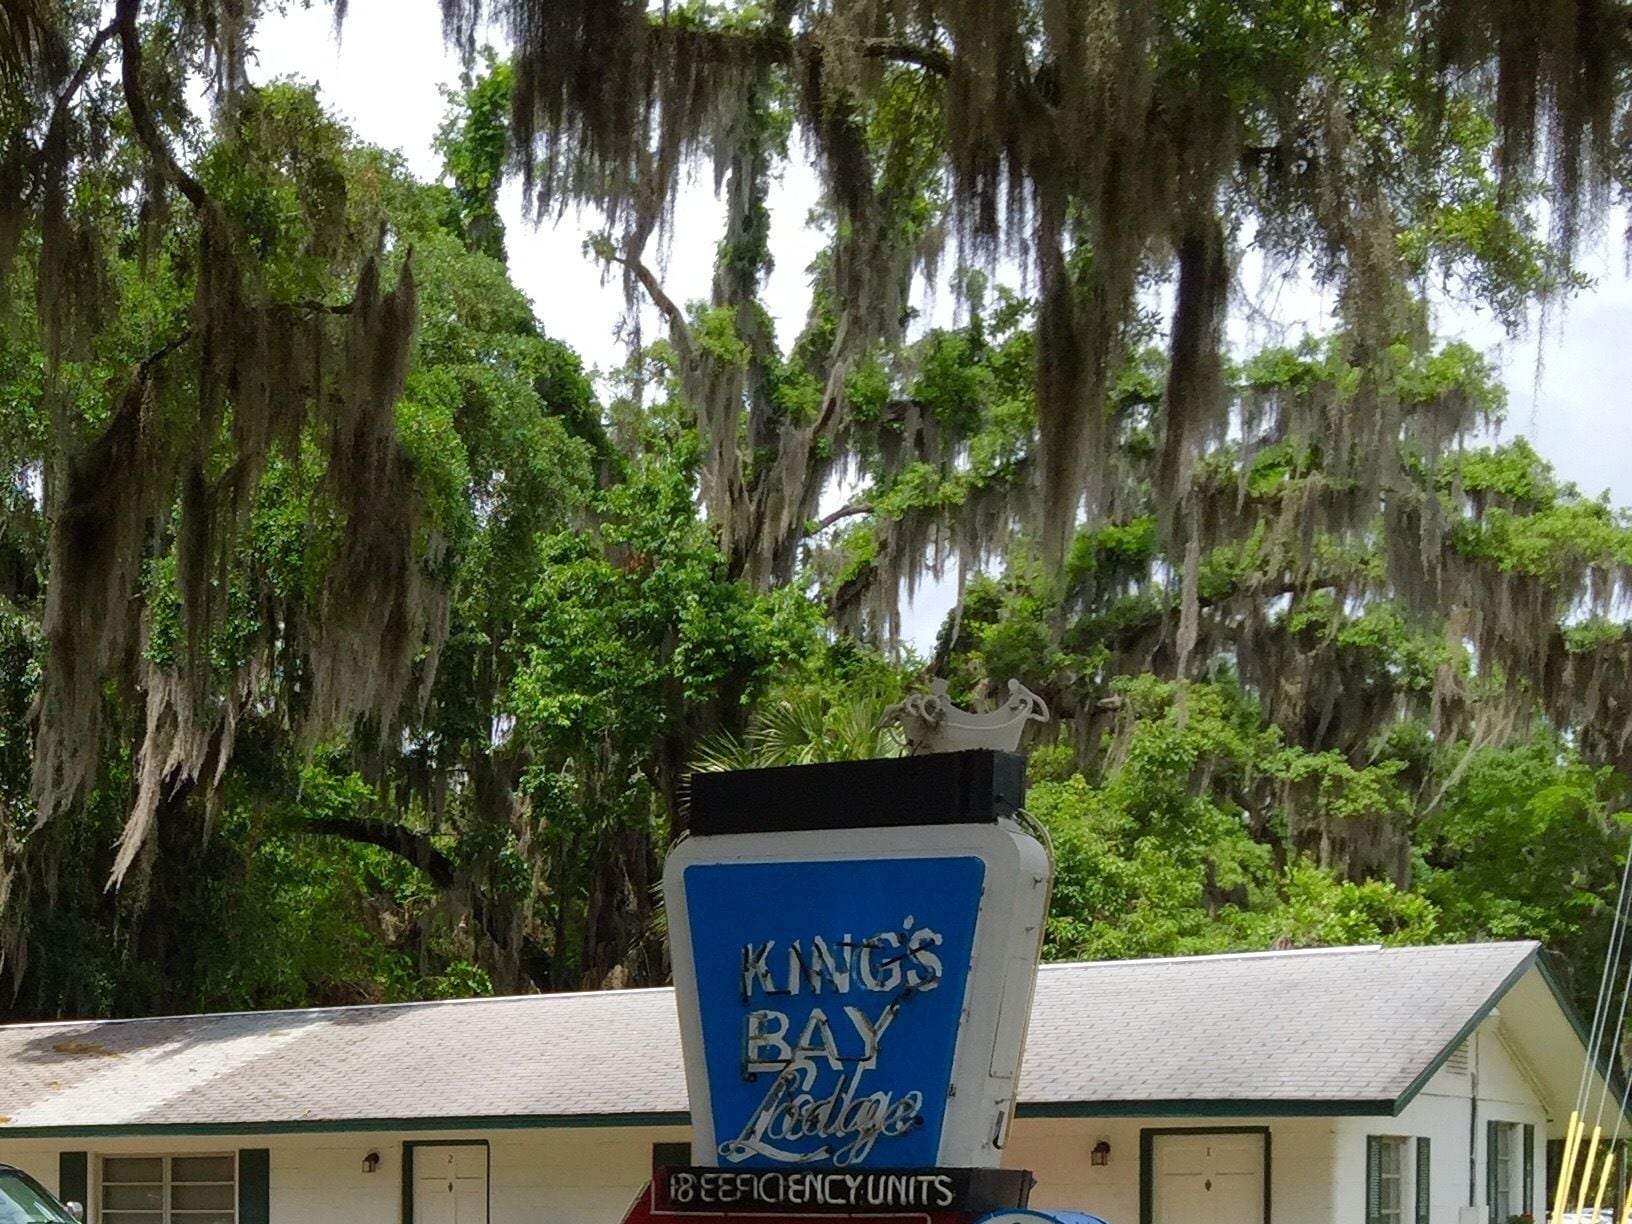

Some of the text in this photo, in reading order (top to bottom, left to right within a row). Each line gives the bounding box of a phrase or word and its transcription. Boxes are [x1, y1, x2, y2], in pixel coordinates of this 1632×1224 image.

[741, 914, 943, 996] KING'S
[742, 1004, 900, 1073] BAY
[718, 1058, 923, 1167] Lodge
[670, 1172, 696, 1203] 18
[867, 1174, 954, 1207] UNITS
